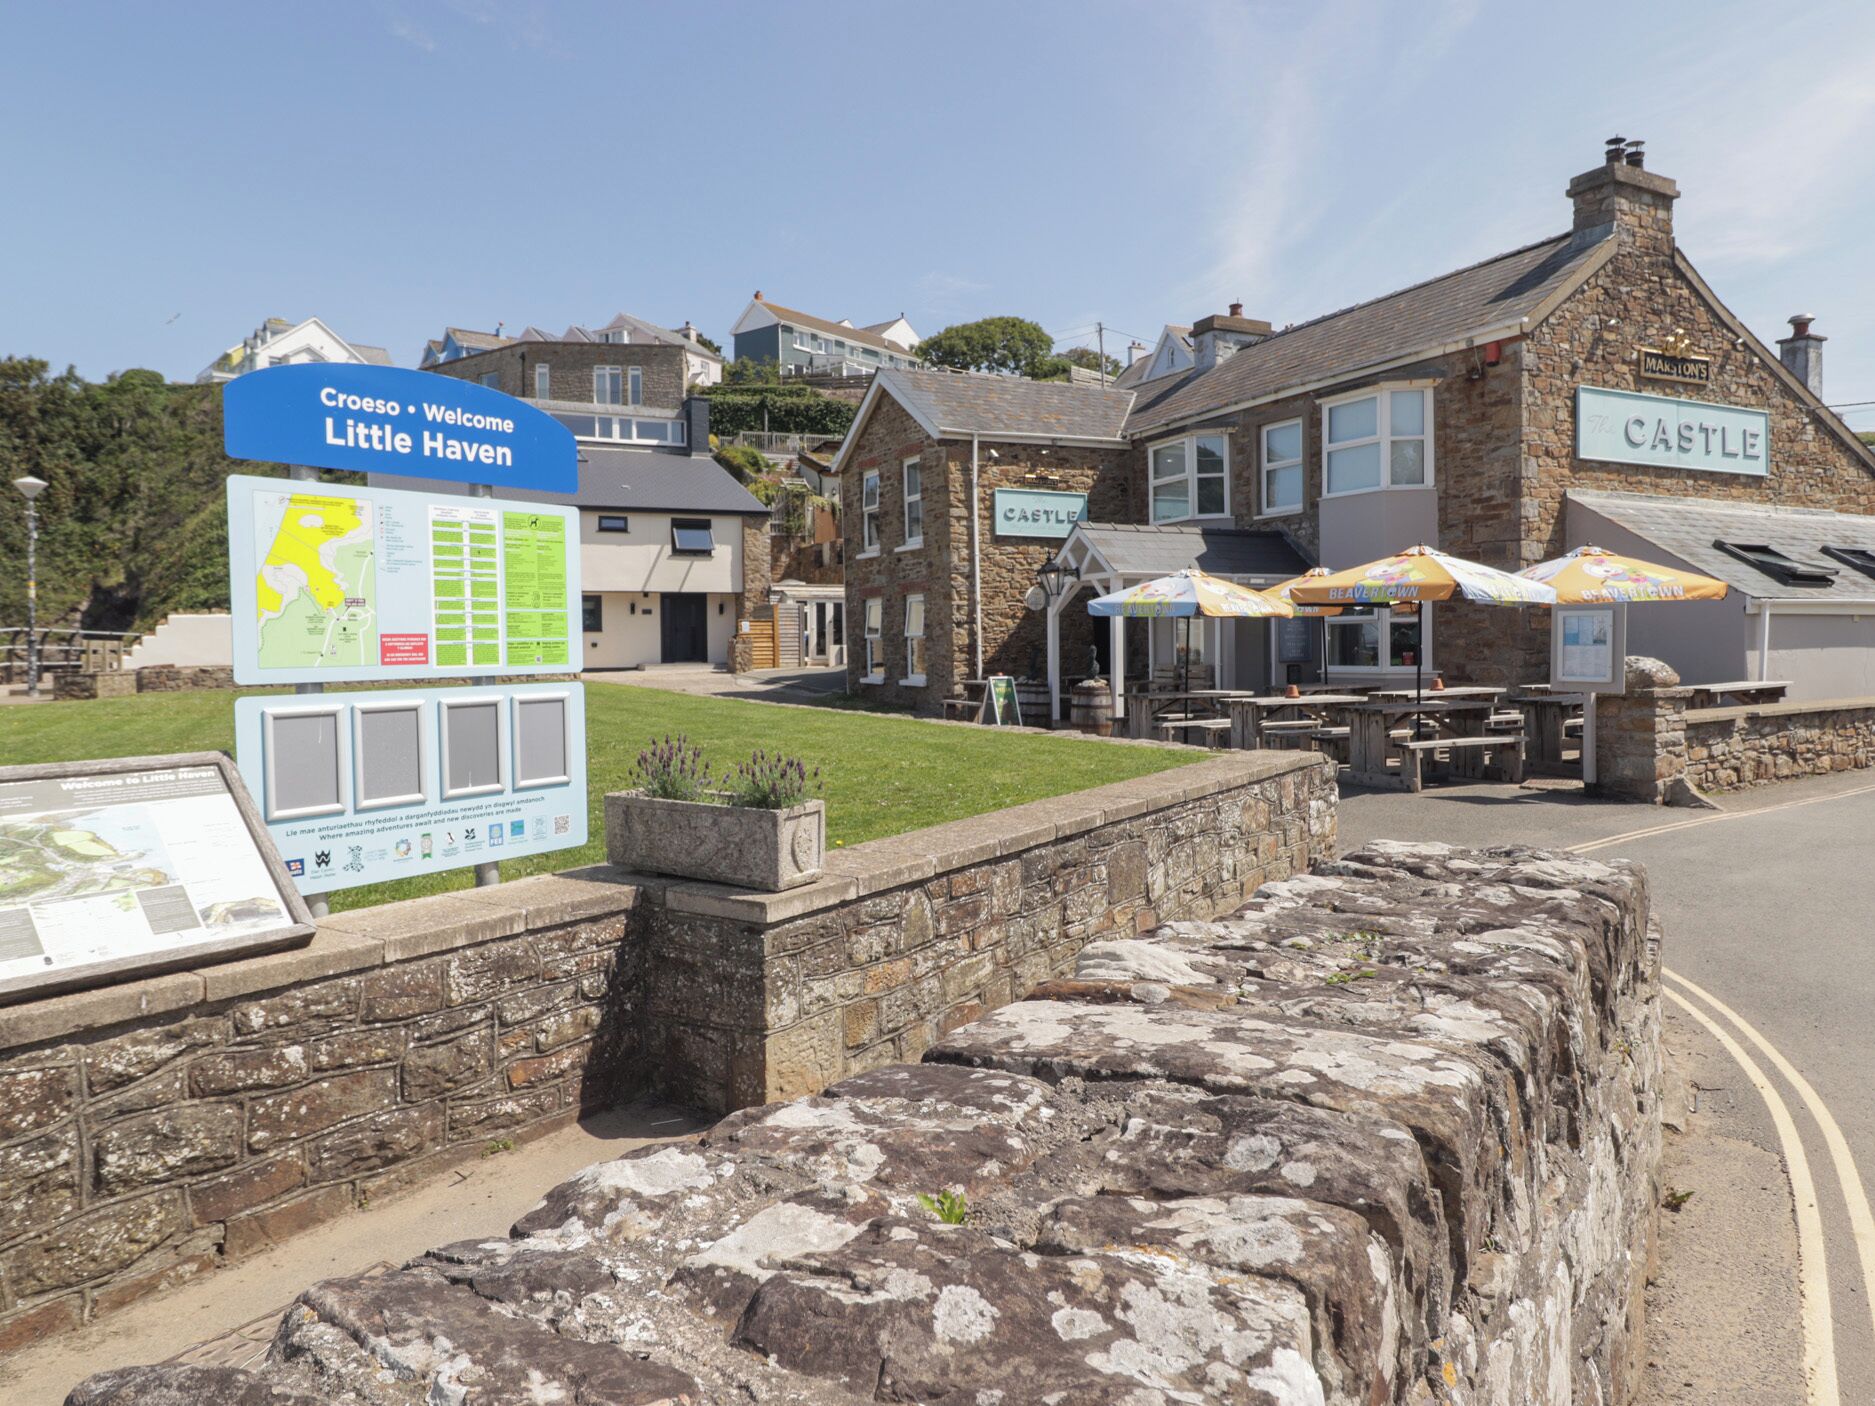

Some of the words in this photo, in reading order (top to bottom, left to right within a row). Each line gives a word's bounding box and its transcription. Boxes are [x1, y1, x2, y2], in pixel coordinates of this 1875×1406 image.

[1645, 356, 1708, 378] MARSTON'S
[320, 387, 400, 416] Croeso
[423, 402, 515, 433] Welcome
[325, 417, 412, 454] Little
[423, 431, 512, 466] Haven
[1587, 414, 1616, 436] The
[1624, 414, 1761, 458] CASTLE
[1003, 507, 1078, 525] CASTLE
[1329, 585, 1420, 600] BEAVERTOWN
[1581, 585, 1685, 600] BEAVERTOWN
[60, 778, 123, 791] Welcome
[125, 776, 140, 785] to
[142, 772, 176, 784] Little
[178, 769, 215, 781] Haven
[318, 822, 363, 833] anturiaethau
[364, 816, 398, 827] rhyfeddol
[460, 804, 484, 814] newydd
[484, 804, 492, 812] yn
[493, 799, 515, 809] disgwyl
[516, 796, 545, 805] amdanoch
[320, 832, 343, 841] Where
[345, 828, 375, 839] amazing
[376, 822, 414, 833] adventures
[415, 819, 432, 828] await
[433, 817, 445, 825] and
[461, 810, 494, 821] discoveries
